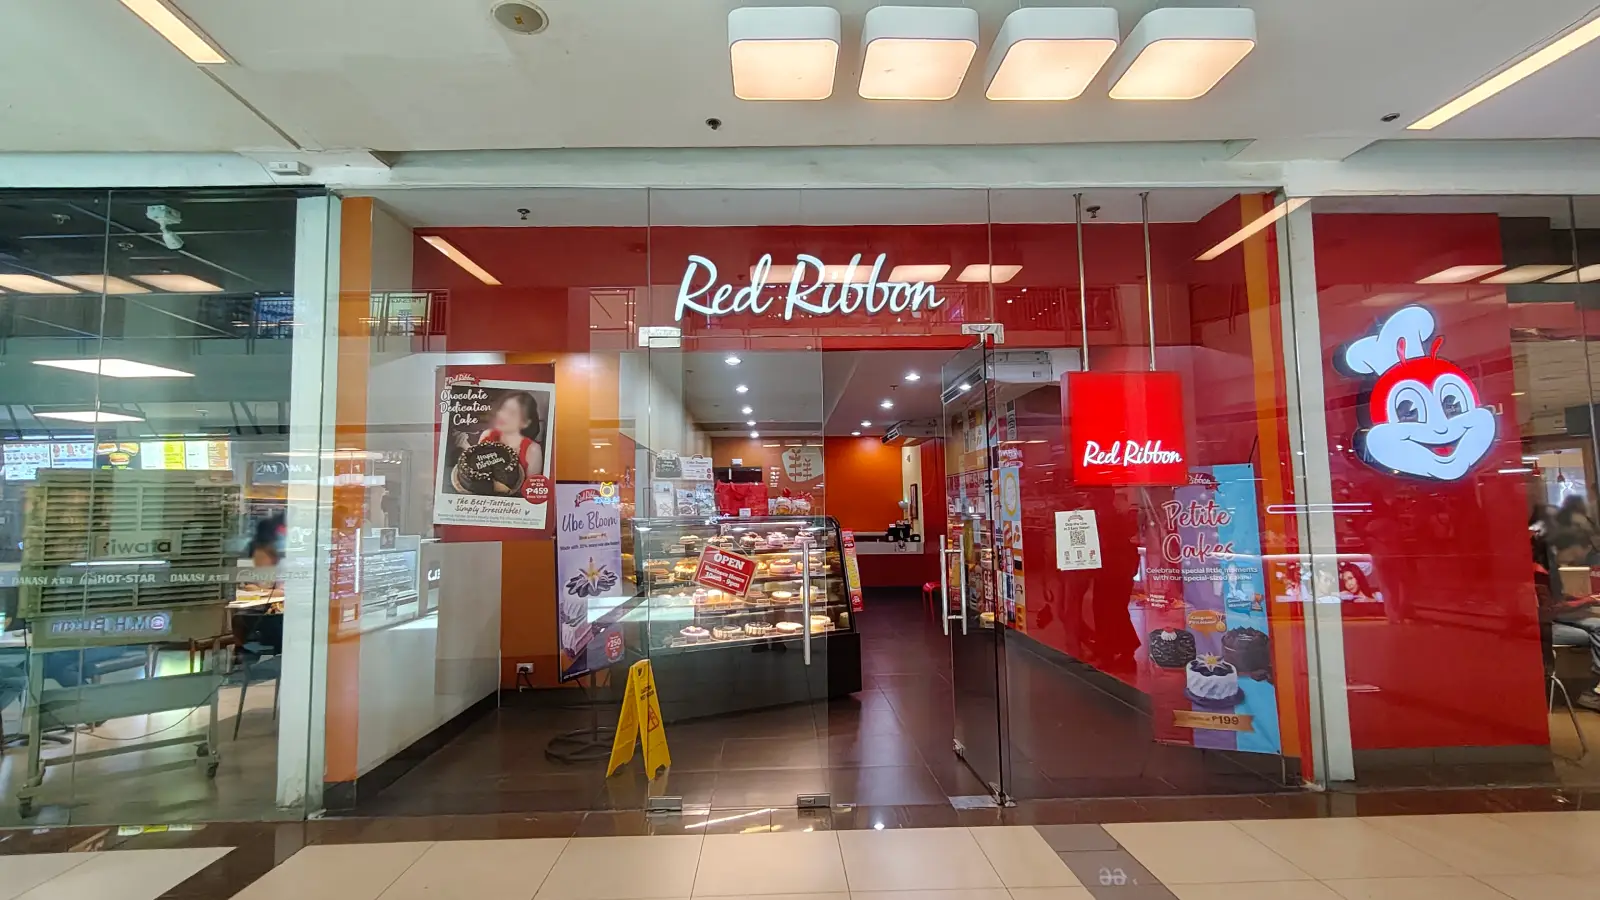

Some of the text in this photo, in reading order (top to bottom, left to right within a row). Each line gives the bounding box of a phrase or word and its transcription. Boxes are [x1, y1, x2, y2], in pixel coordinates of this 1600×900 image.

[674, 253, 946, 321] Red Ribbon
[440, 388, 488, 401] Chocolate
[440, 400, 492, 414] Dedication
[453, 413, 479, 426] Cake
[476, 452, 498, 461] Happy
[1083, 440, 1182, 467] Red Ribbon
[476, 457, 506, 470] Birthday
[456, 497, 469, 505] The
[454, 505, 480, 514] Simply
[1162, 500, 1233, 530] Petite
[562, 513, 585, 533] Ube
[586, 510, 617, 530] Bloom
[1162, 532, 1235, 564] Cakes
[714, 553, 746, 570] OPEN
[1181, 567, 1205, 576] special
[11, 576, 48, 586] DAKASI
[97, 573, 156, 584] HOT-STAR
[170, 573, 205, 583] DAKASI
